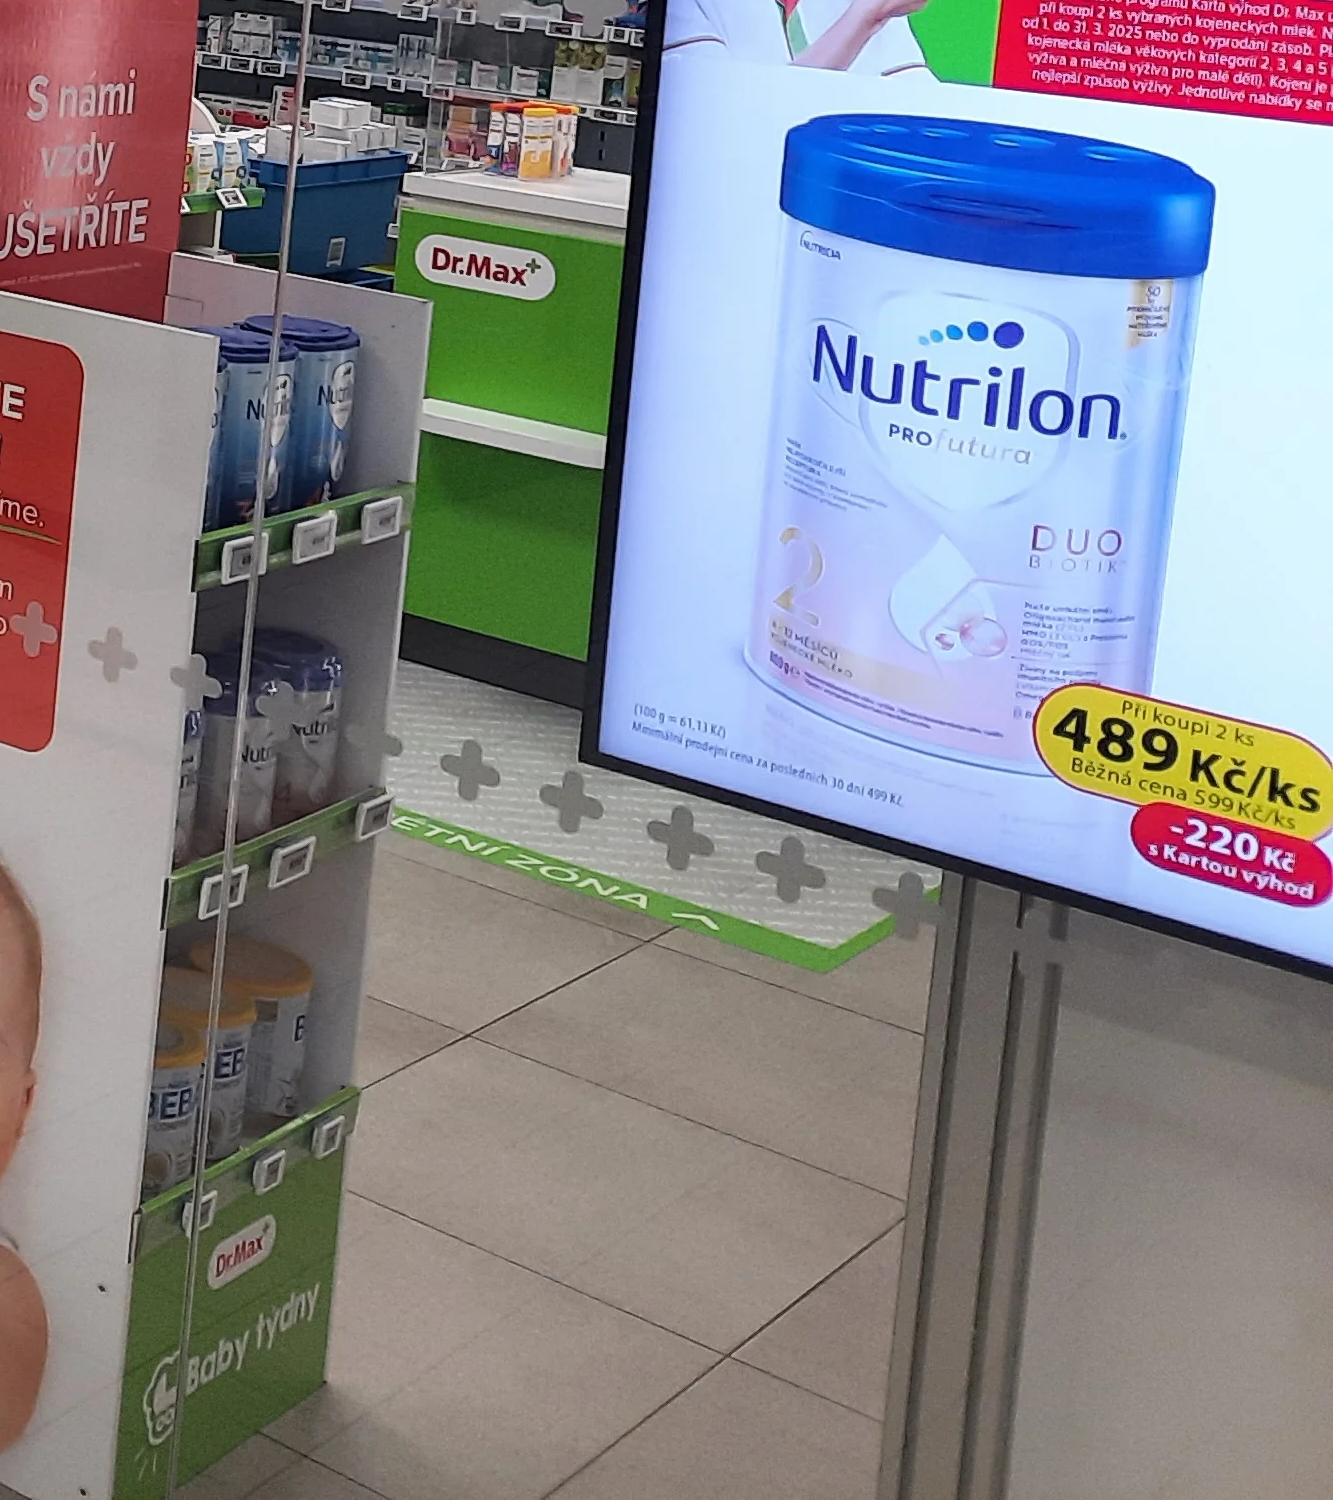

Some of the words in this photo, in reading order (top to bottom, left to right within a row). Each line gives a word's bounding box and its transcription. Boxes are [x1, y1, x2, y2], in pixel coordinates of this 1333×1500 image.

[1022, 17, 1039, 29] od
[1053, 19, 1070, 32] do
[1107, 23, 1142, 39] 2025
[1145, 27, 1178, 43] nebo
[1182, 31, 1199, 45] do
[1096, 5, 1105, 19] 2
[1109, 6, 1123, 20] ks
[1195, 13, 1278, 36] kojeneckých
[1295, 6, 1325, 21] Max
[1027, 32, 1090, 50] kojenecká
[1093, 40, 1132, 56] mléka
[1027, 51, 1067, 67] výživa
[1080, 55, 1127, 72] mléčná
[1171, 67, 1194, 80] pro
[25, 73, 49, 122] S
[58, 68, 137, 118] námi
[431, 246, 527, 287] Dr.Max
[812, 324, 1124, 440] Nutrilon
[888, 423, 1031, 466] PROfutura
[1032, 524, 1123, 557] DUO
[773, 525, 824, 626] 2
[1122, 700, 1147, 721] Při
[1216, 722, 1226, 741] 2
[1235, 727, 1255, 748] ks
[632, 721, 683, 746] Minimální
[685, 736, 728, 759] prodejní
[730, 750, 753, 765] cena
[756, 757, 769, 768] za
[770, 761, 828, 787] posledních
[847, 781, 865, 796] dní
[867, 787, 888, 802] 499
[1053, 707, 1178, 772] 489
[1190, 748, 1321, 813] Kč/ks
[1071, 757, 1132, 787] Běžná
[1138, 778, 1187, 802] cena
[1194, 789, 1233, 813] 599
[1238, 800, 1296, 831] Kč/ks
[1169, 817, 1259, 861] -220
[1264, 846, 1295, 873] Kč
[505, 851, 651, 910] ZÓNA
[1148, 845, 1158, 857] s
[1164, 843, 1237, 879] Kartou
[1243, 867, 1315, 900] výhod
[215, 1235, 264, 1279] Dr.Max
[184, 1328, 249, 1396] Baby
[256, 1282, 320, 1352] týdny
